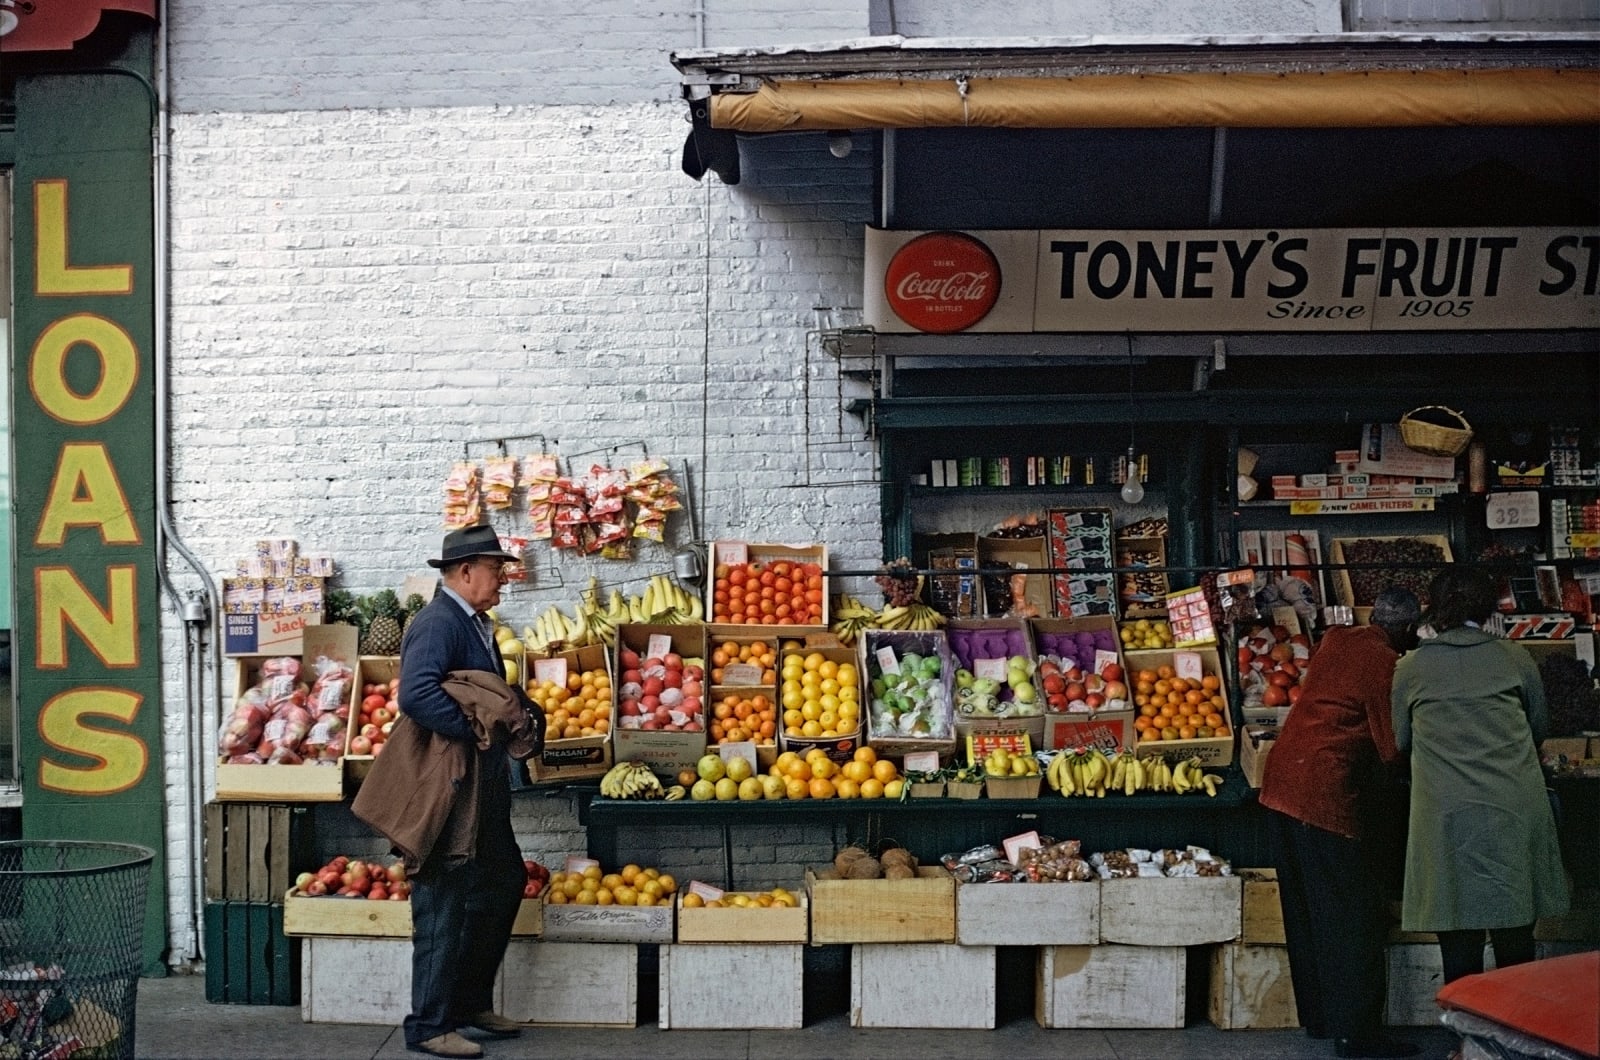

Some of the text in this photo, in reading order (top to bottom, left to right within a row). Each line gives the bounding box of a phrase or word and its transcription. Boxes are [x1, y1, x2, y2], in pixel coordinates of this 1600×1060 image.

[1050, 230, 1309, 300] TONEY'S
[1341, 236, 1518, 298] FRUIT
[896, 271, 990, 300] Coca-Cola
[1266, 299, 1475, 320] Since 1905
[29, 178, 149, 796] LOANS
[1350, 502, 1377, 511] CAMEL
[1379, 500, 1413, 510] FILTERS
[228, 615, 255, 625] SINGLE
[272, 618, 307, 634] Jack
[229, 626, 254, 636] BOXES
[543, 749, 589, 760] PHEASANT
